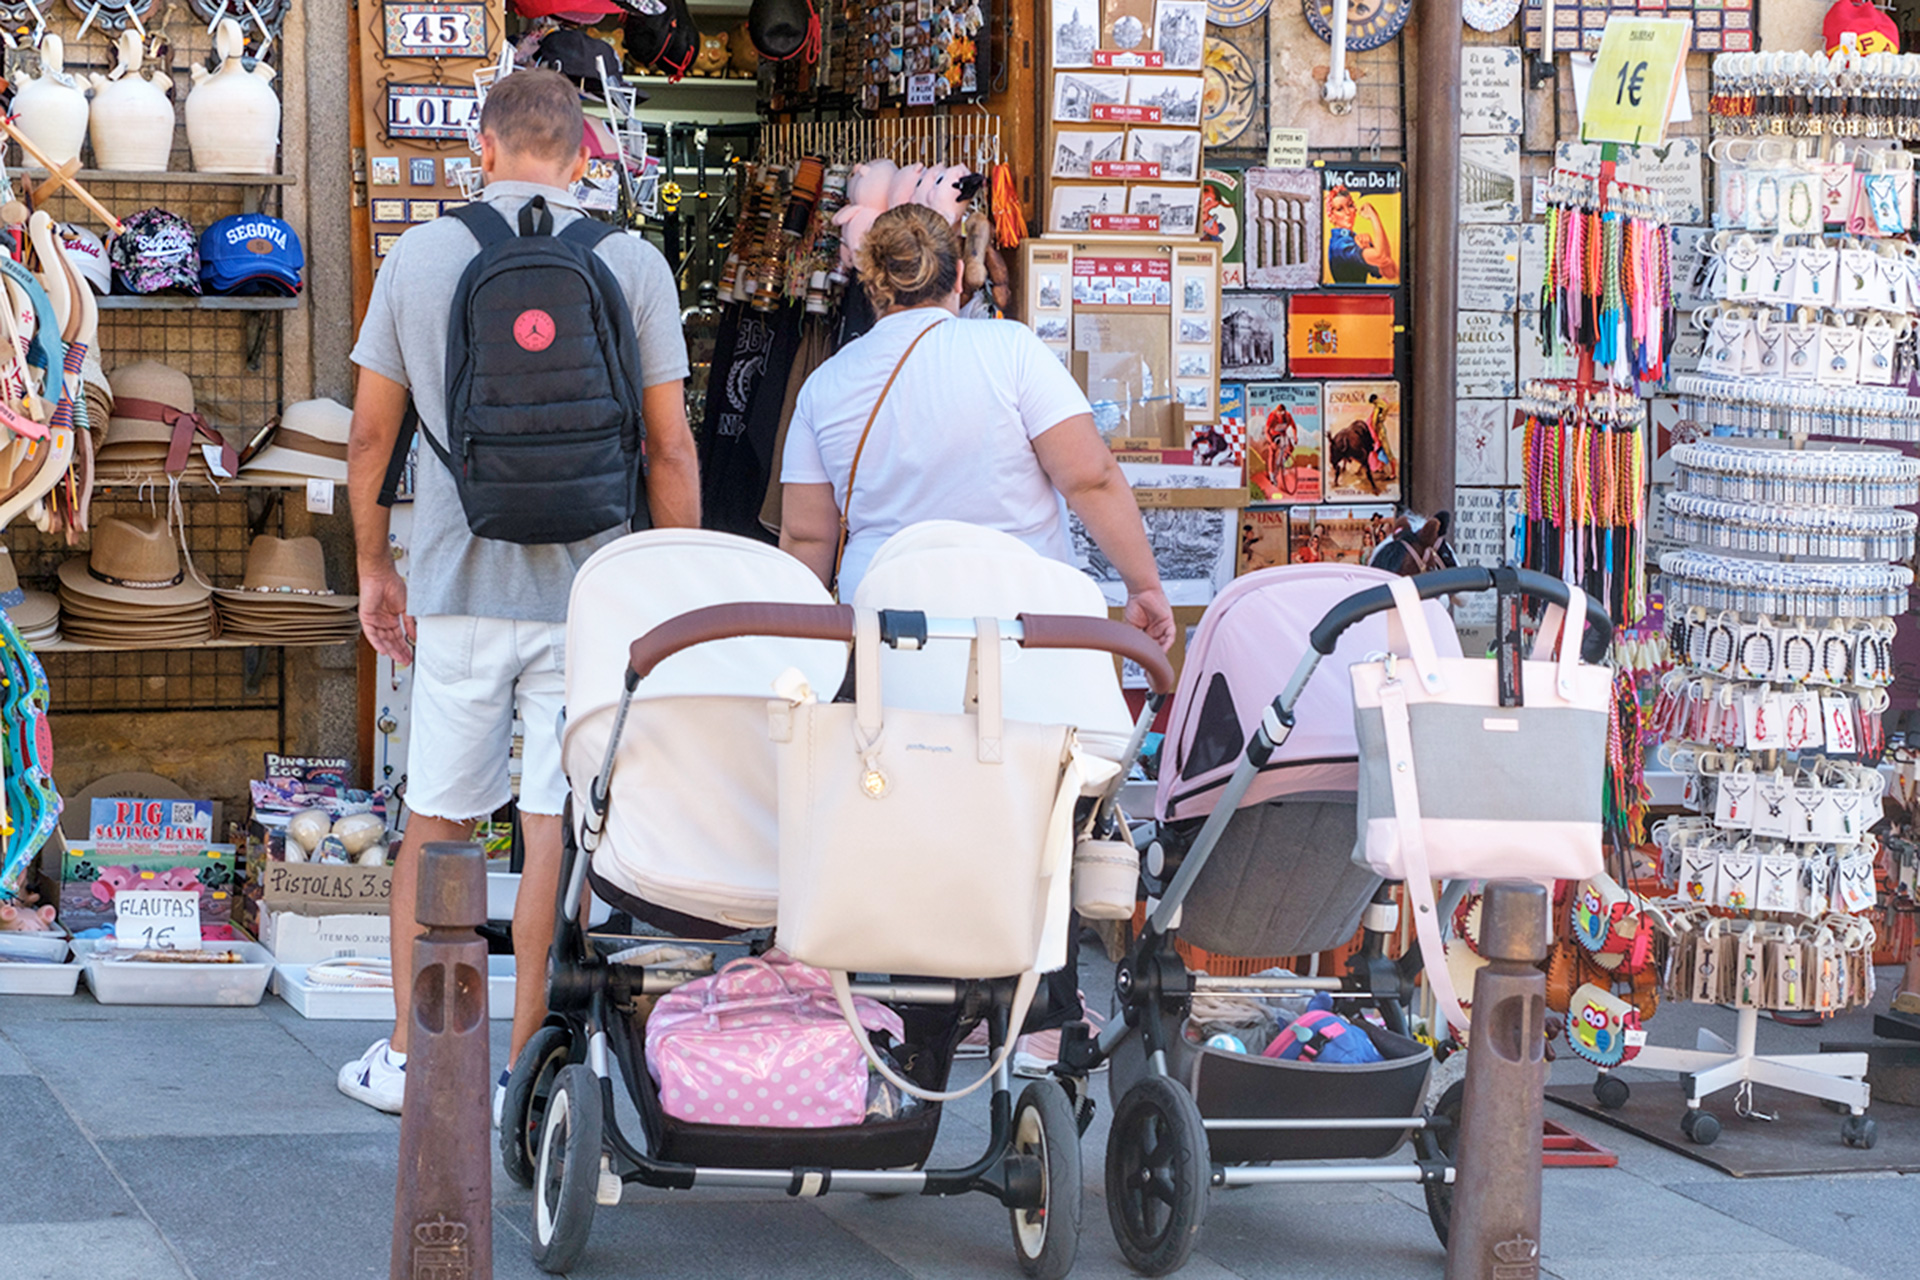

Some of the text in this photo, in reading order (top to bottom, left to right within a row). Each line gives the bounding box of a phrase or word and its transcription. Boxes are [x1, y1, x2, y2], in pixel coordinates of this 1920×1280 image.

[412, 15, 459, 44] 45
[1616, 60, 1648, 107] 1€
[1324, 170, 1343, 188] We
[1344, 171, 1367, 187] Can
[1368, 171, 1385, 187] Do
[1386, 170, 1401, 188] It!
[225, 222, 288, 250] SEGOVIA
[267, 753, 347, 768] DINOSAUR
[269, 766, 302, 777] EGG
[114, 801, 163, 826] PIG
[95, 824, 206, 842] SAVINGS BANK
[120, 898, 195, 917] FLAUTAS
[141, 926, 175, 949] 1€
